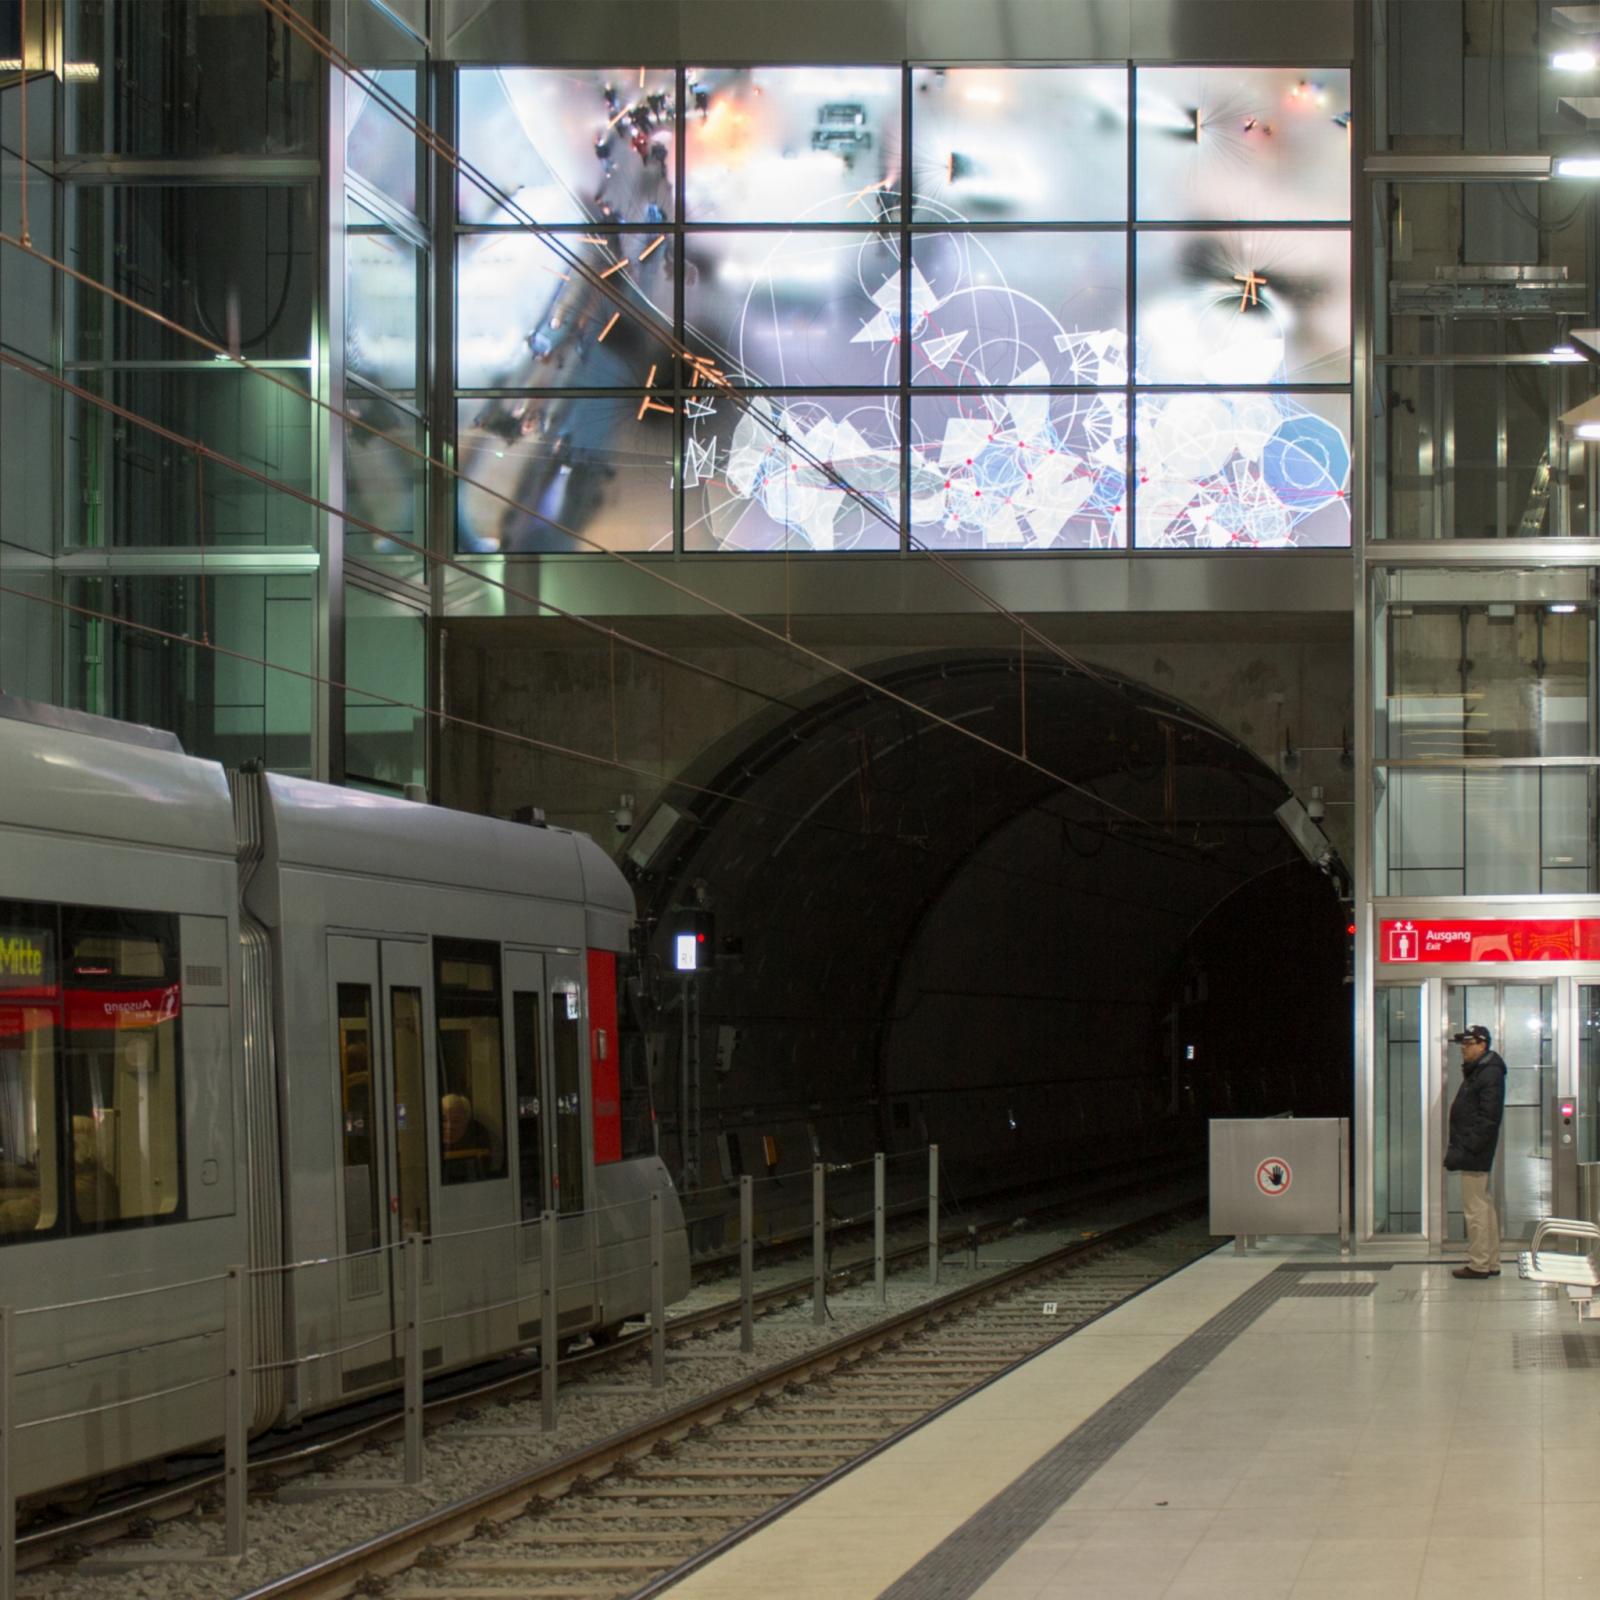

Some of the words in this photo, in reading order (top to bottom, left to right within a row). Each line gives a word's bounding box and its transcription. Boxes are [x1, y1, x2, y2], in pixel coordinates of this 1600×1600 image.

[1425, 930, 1471, 943] Ausgang
[1425, 942, 1441, 951] Exit
[0, 937, 43, 976] Mitte
